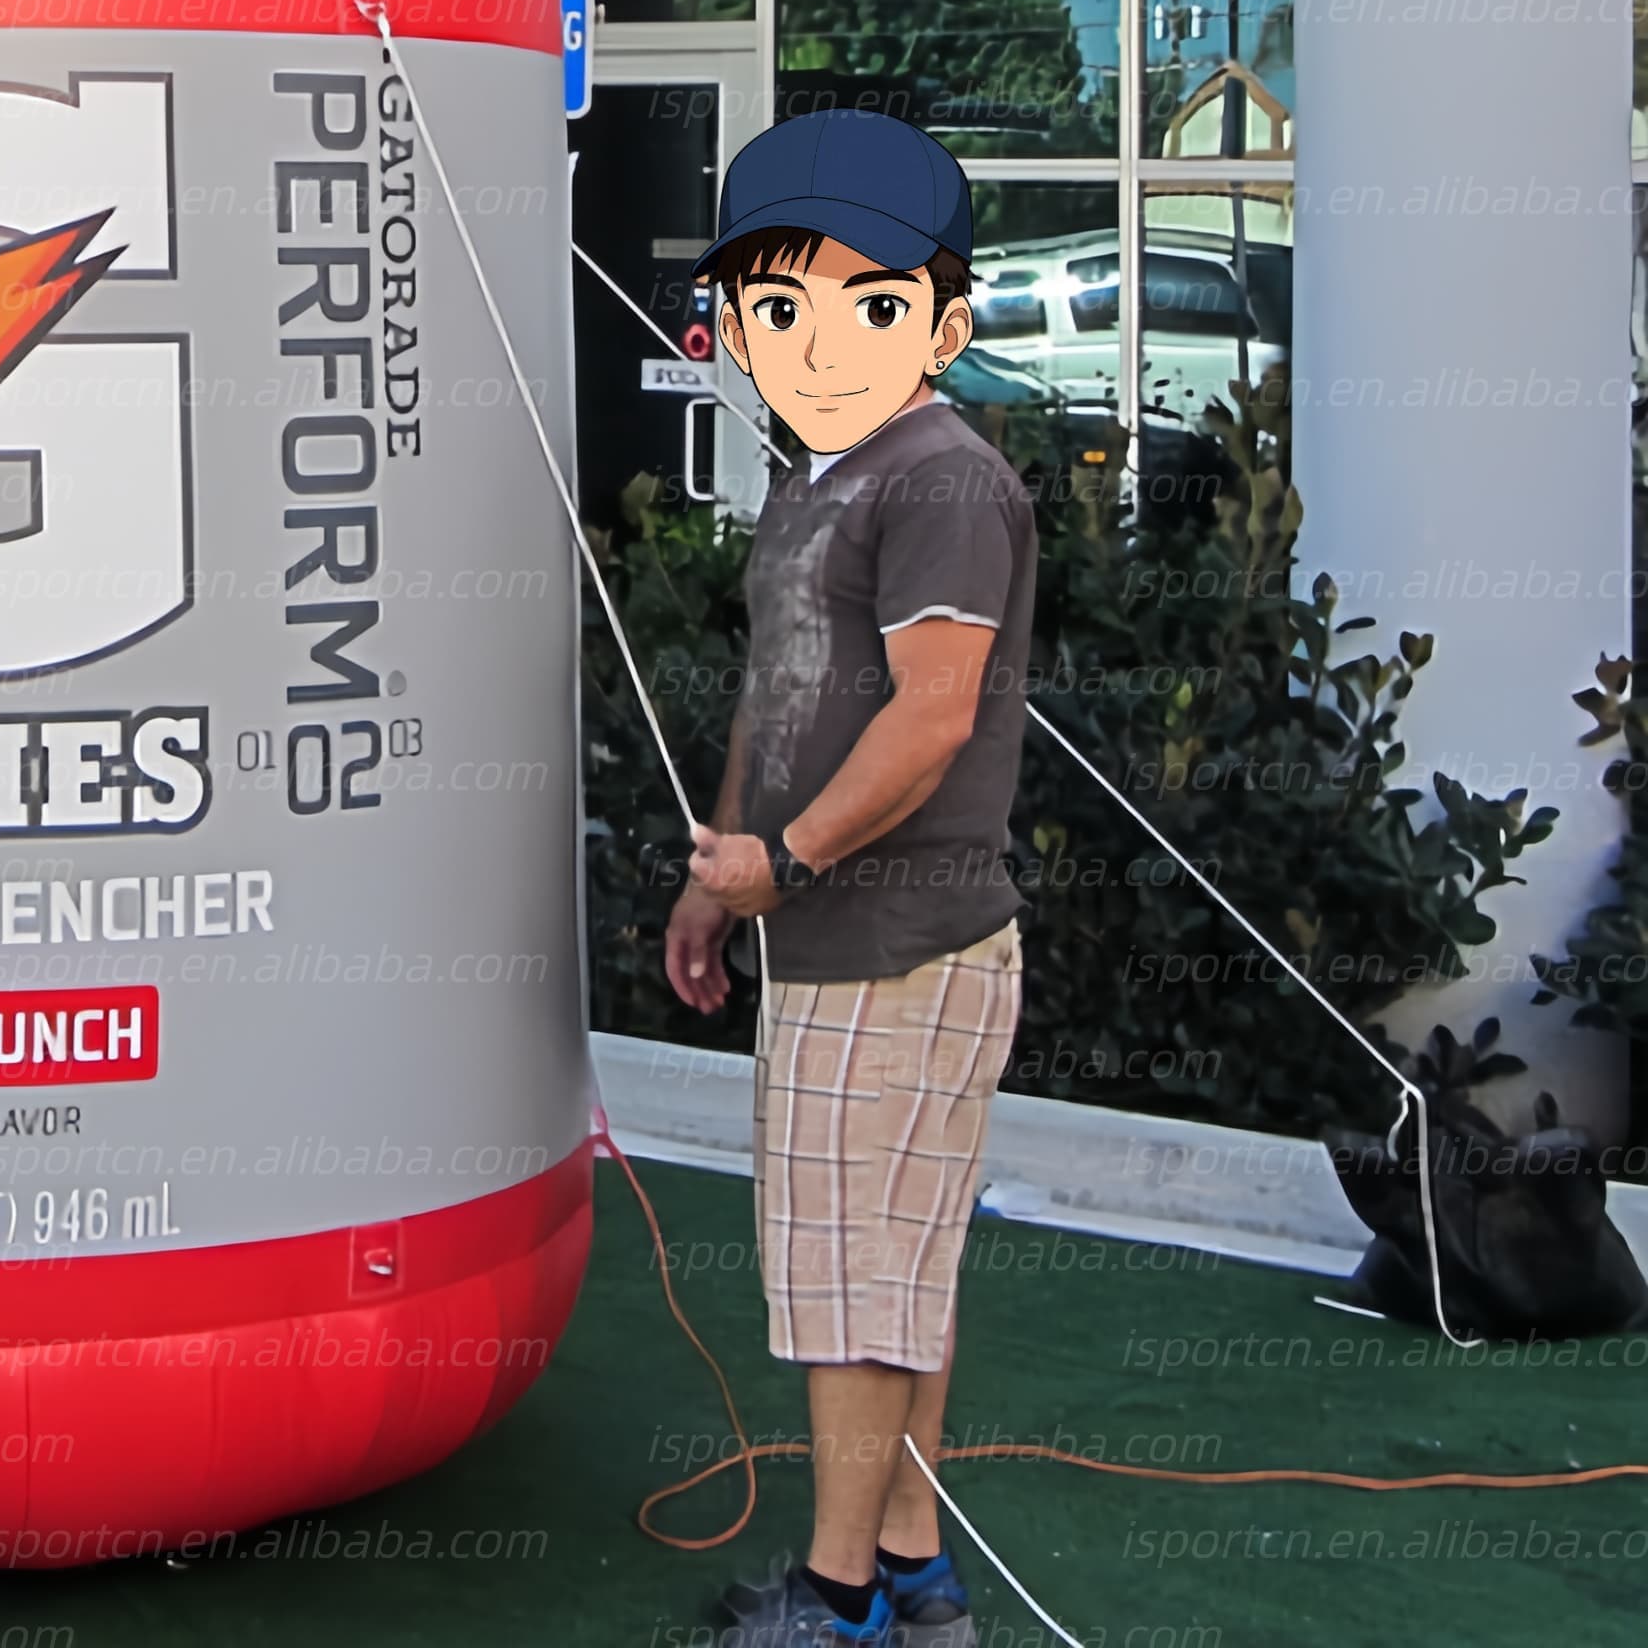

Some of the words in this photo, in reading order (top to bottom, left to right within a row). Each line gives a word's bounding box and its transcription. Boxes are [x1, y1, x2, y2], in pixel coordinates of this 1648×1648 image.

[378, 74, 421, 457] GATORADE
[272, 71, 381, 704] PERFORM
[237, 730, 276, 771] 01
[287, 720, 382, 815] 02
[33, 1188, 108, 1243] 946
[123, 1181, 181, 1239] mL
